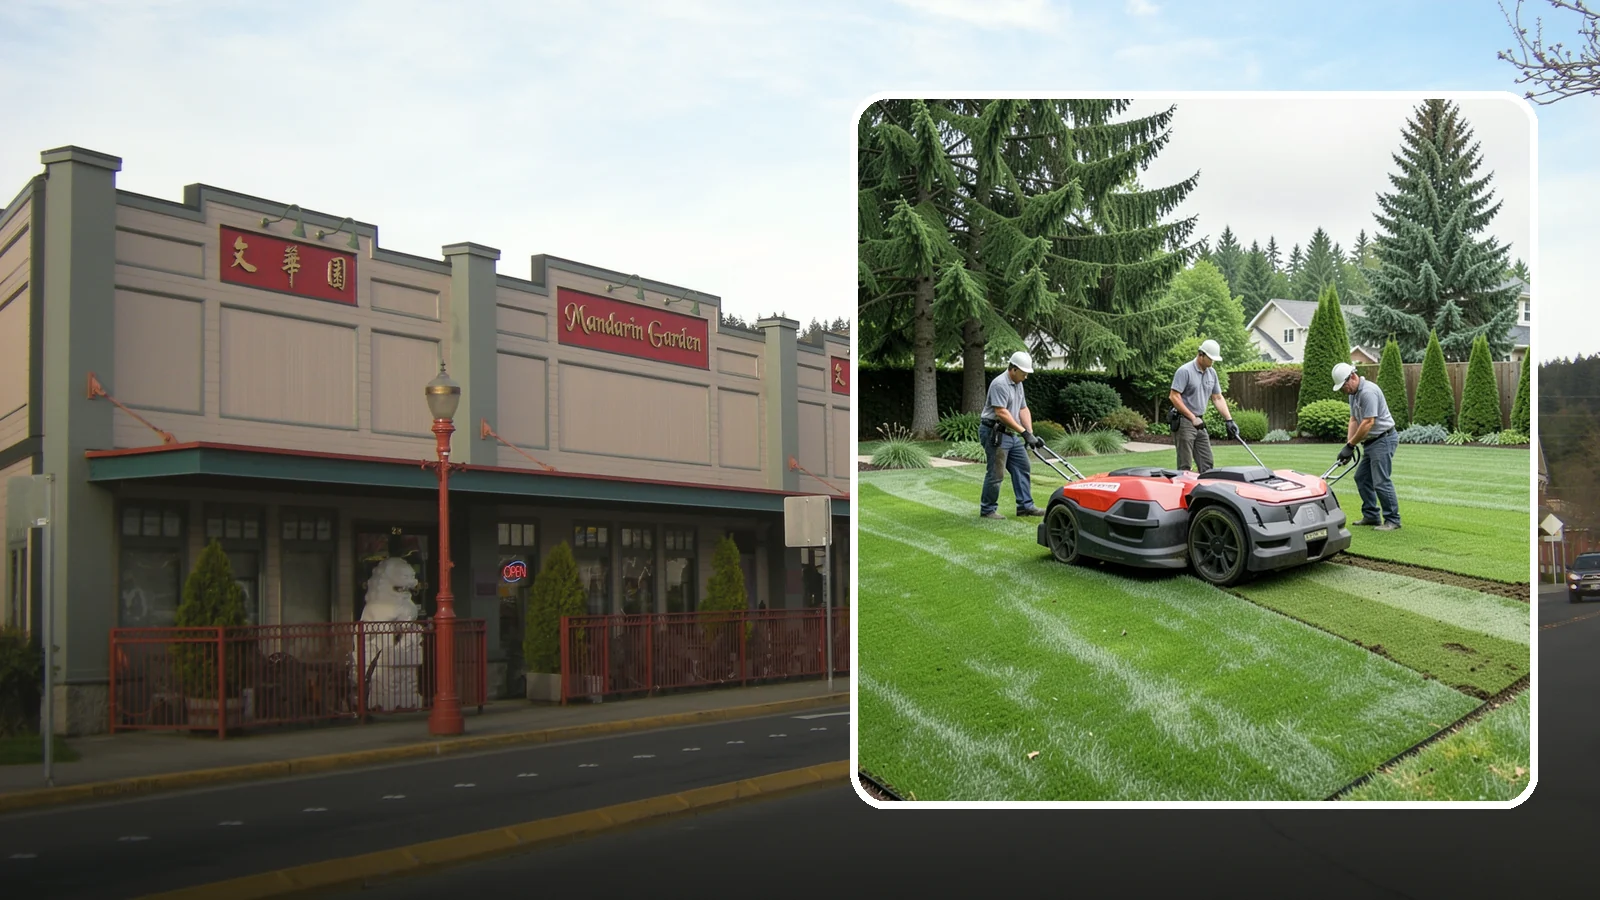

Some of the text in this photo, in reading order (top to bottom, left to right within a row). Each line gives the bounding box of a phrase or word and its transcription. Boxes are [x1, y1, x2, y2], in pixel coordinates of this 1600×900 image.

[230, 235, 346, 291] 文華園
[564, 302, 701, 352] Mandarin Garden
[503, 565, 527, 578] OPEN
